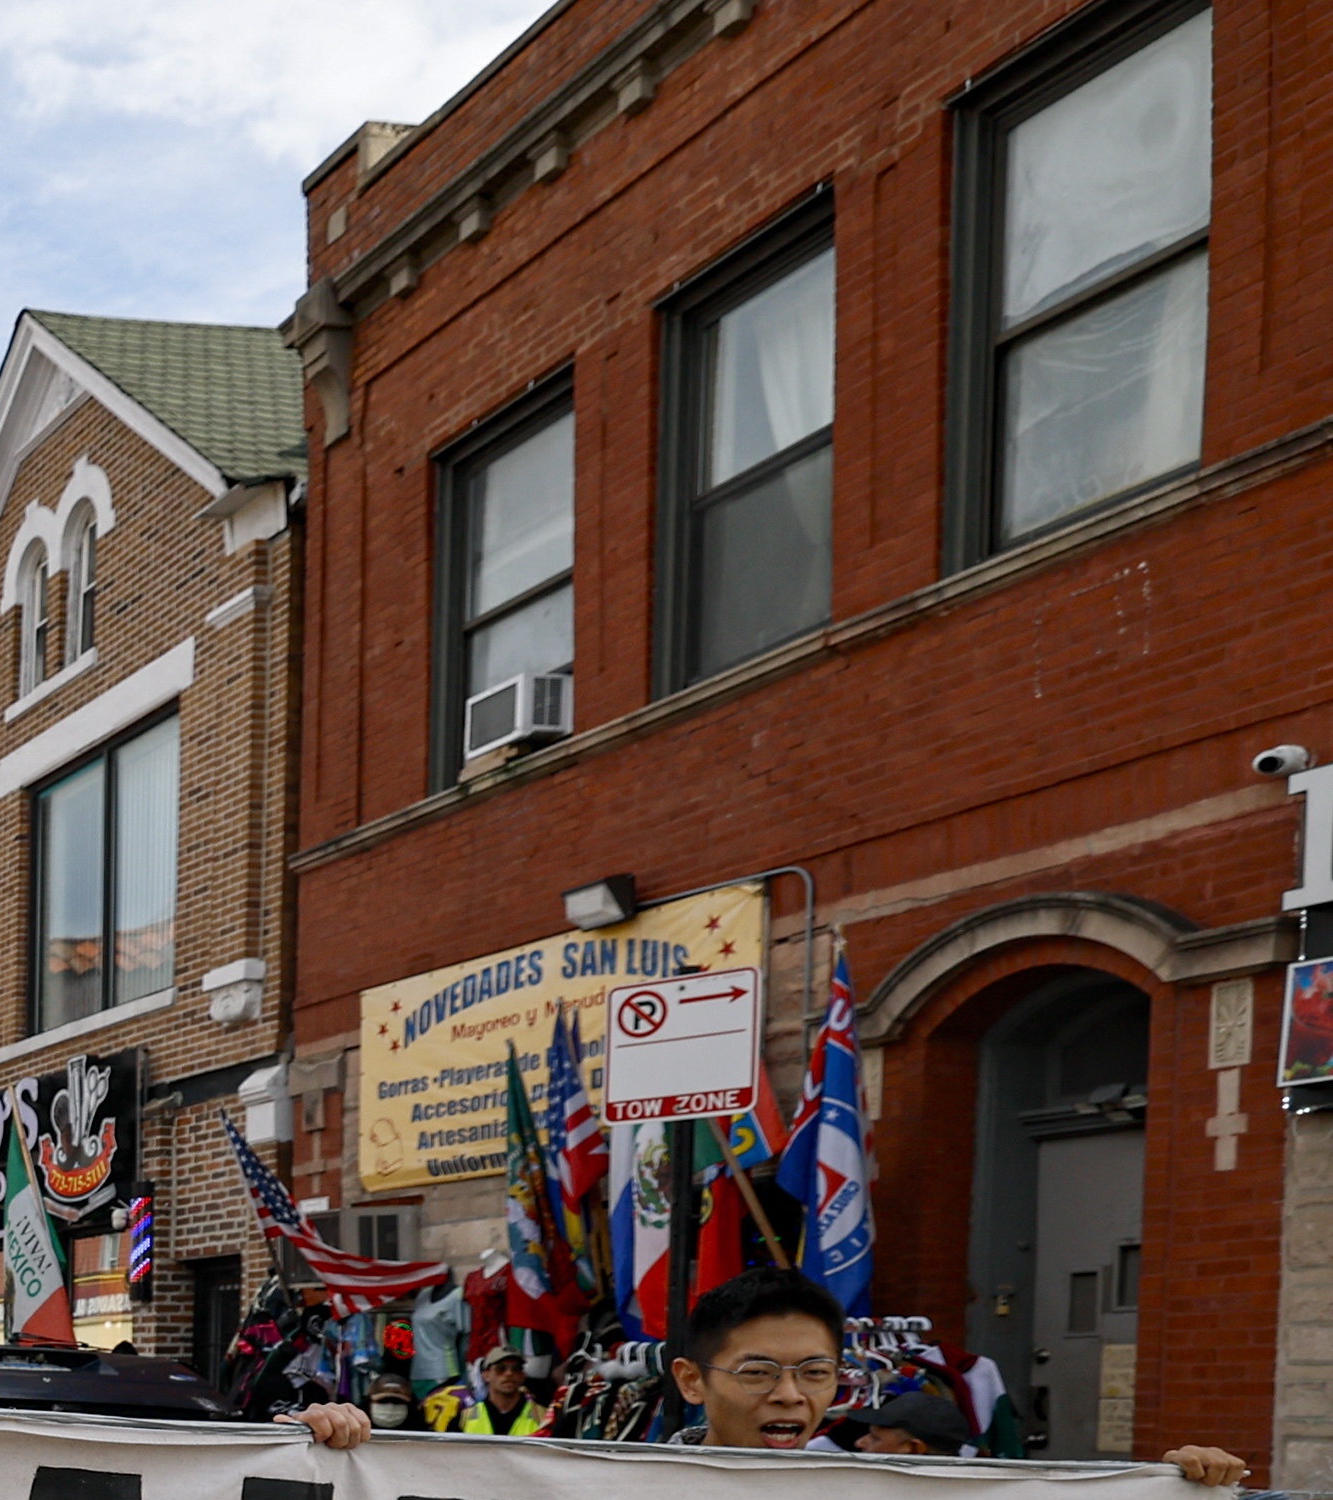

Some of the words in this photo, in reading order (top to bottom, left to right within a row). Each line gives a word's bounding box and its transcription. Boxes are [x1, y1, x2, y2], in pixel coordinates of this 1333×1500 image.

[404, 950, 544, 1049] NOVEDADES
[562, 939, 618, 979] SAN
[626, 938, 689, 979] LUIS
[451, 1012, 520, 1042] Mayoreo
[526, 1007, 538, 1027] y
[544, 985, 606, 1018] Menud
[378, 1074, 429, 1100] Gorras
[412, 1088, 509, 1123] Accesorio
[612, 1098, 664, 1120] TOW
[673, 1089, 742, 1115] ZONE
[417, 1119, 509, 1151] Artesania
[427, 1151, 509, 1178] Uniform
